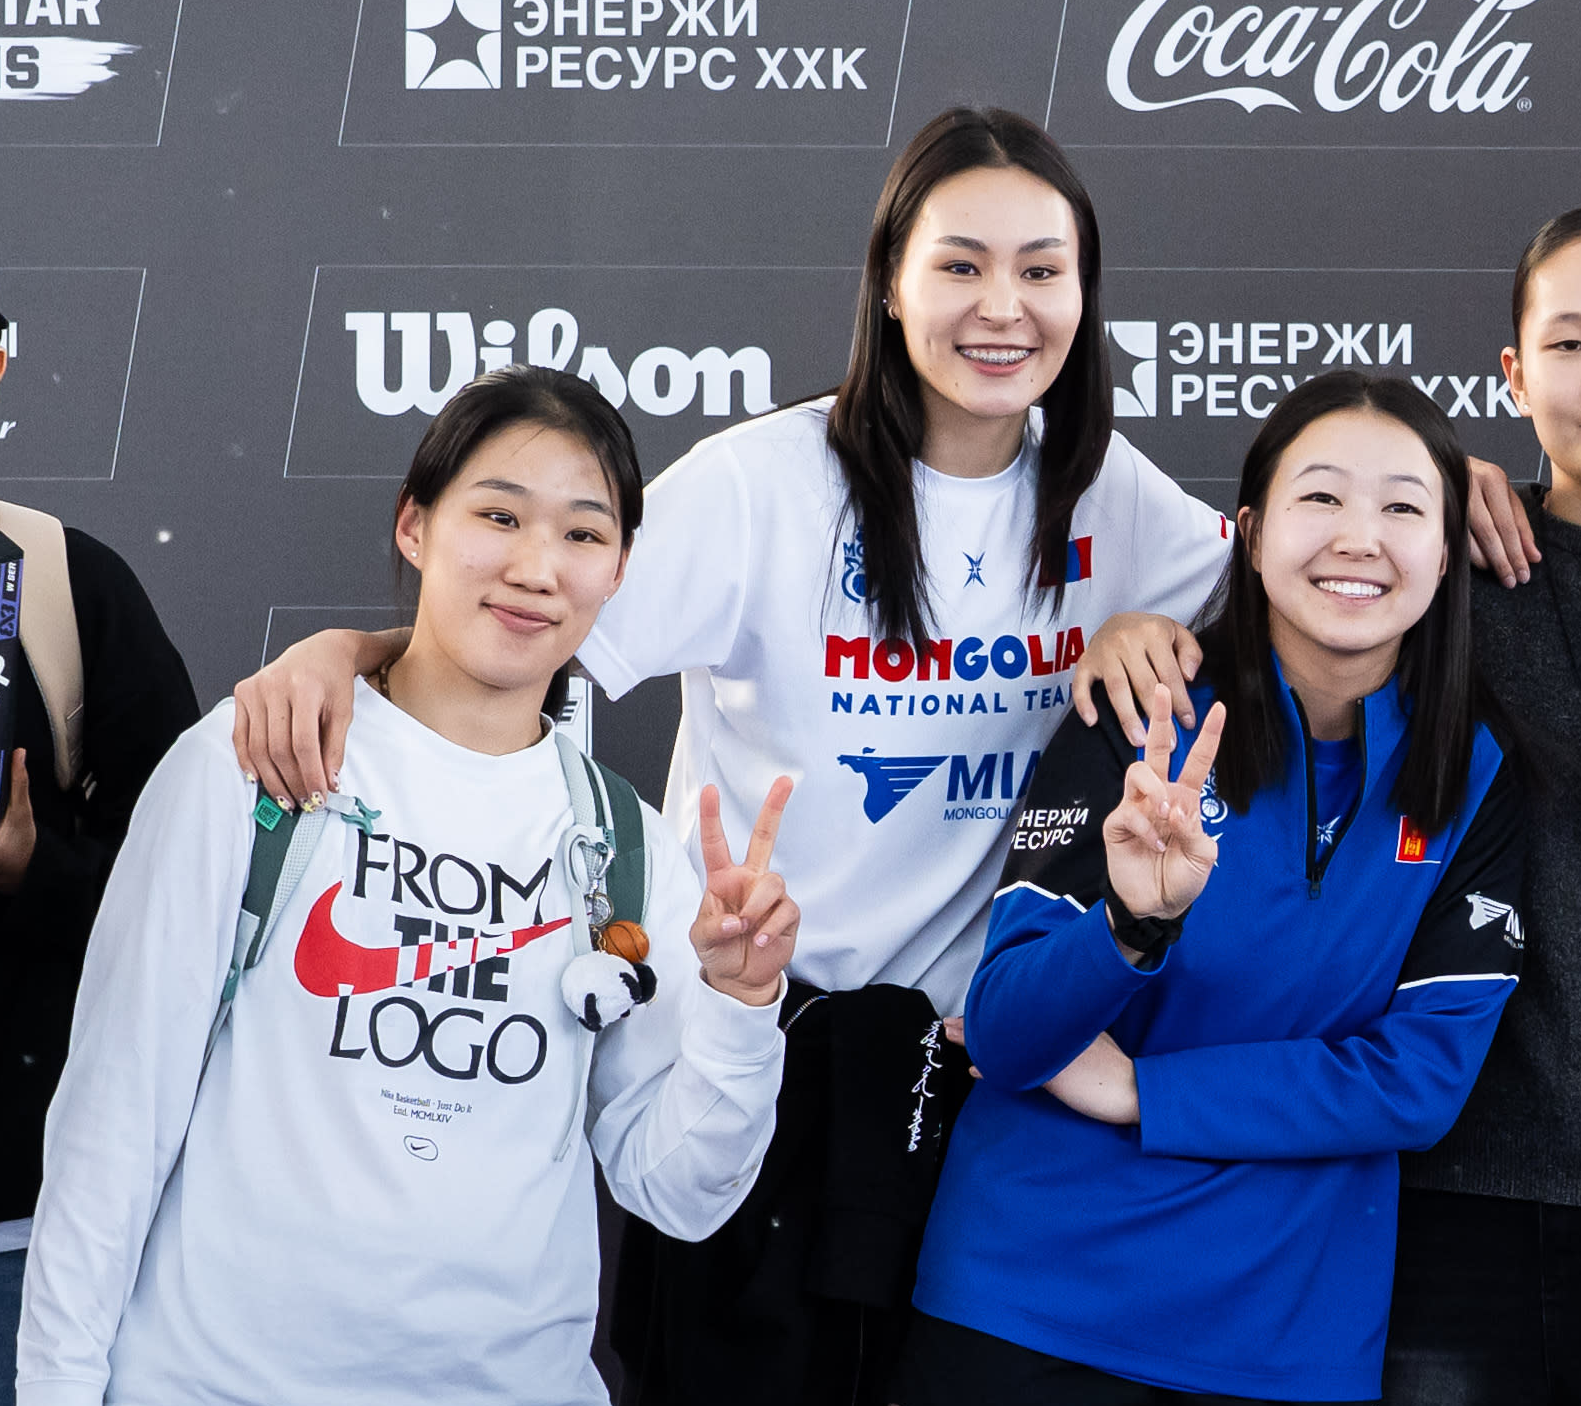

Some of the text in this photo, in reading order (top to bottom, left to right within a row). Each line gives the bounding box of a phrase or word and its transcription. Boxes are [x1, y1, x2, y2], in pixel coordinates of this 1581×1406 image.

[515, 47, 868, 93] РЕСУРС ХХК
[346, 308, 777, 417] Wilson
[1169, 322, 1413, 366] ЭНЕРЖИ
[824, 626, 1087, 684] MONGOLIA
[831, 683, 1072, 718] NATIONAL TEA
[942, 805, 1010, 822] MONGOLI
[1017, 808, 1088, 828] НЕРЖИ
[1009, 828, 1074, 850] ЕСУРС
[353, 827, 553, 925] FROM
[393, 913, 511, 1003] THE
[328, 983, 547, 1085] LOGO
